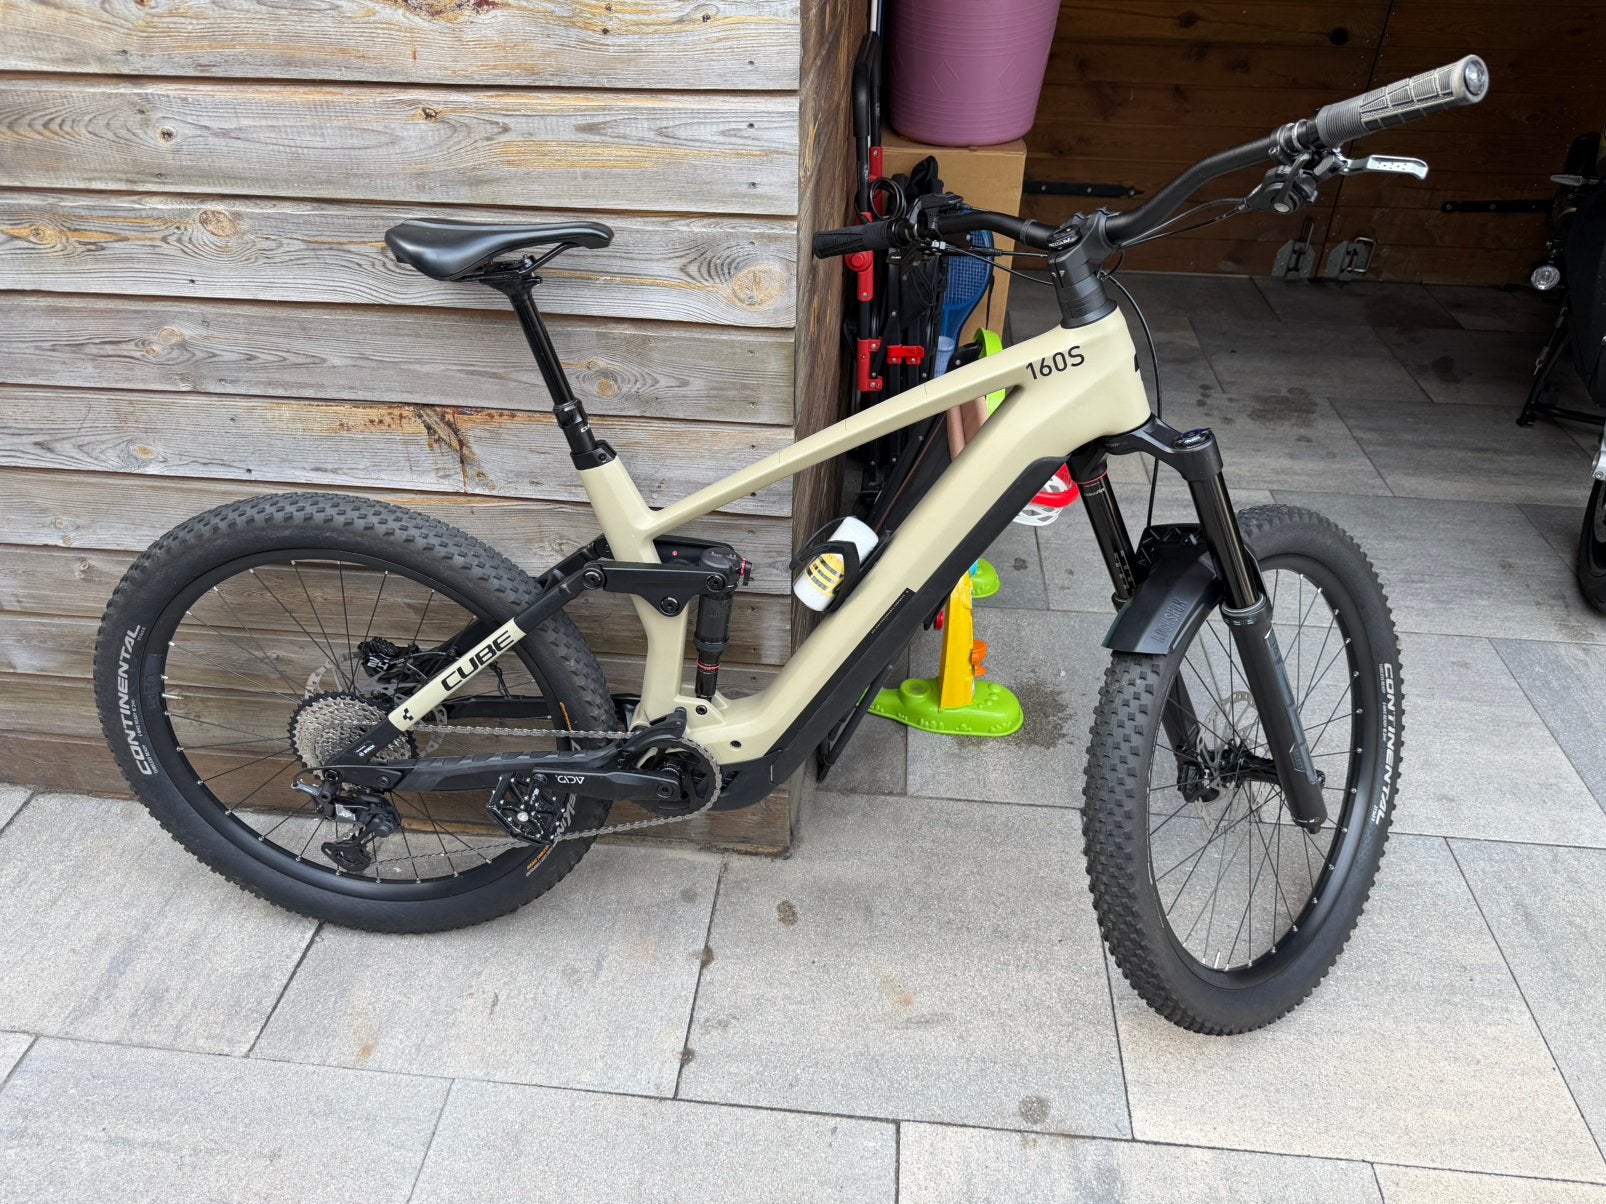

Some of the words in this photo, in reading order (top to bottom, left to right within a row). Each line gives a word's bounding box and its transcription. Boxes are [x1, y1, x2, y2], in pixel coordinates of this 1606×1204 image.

[1025, 345, 1085, 380] 160S
[117, 624, 153, 776] CONTINENTAL
[440, 629, 515, 692] CUBE
[1375, 662, 1396, 825] CONTINENTAL
